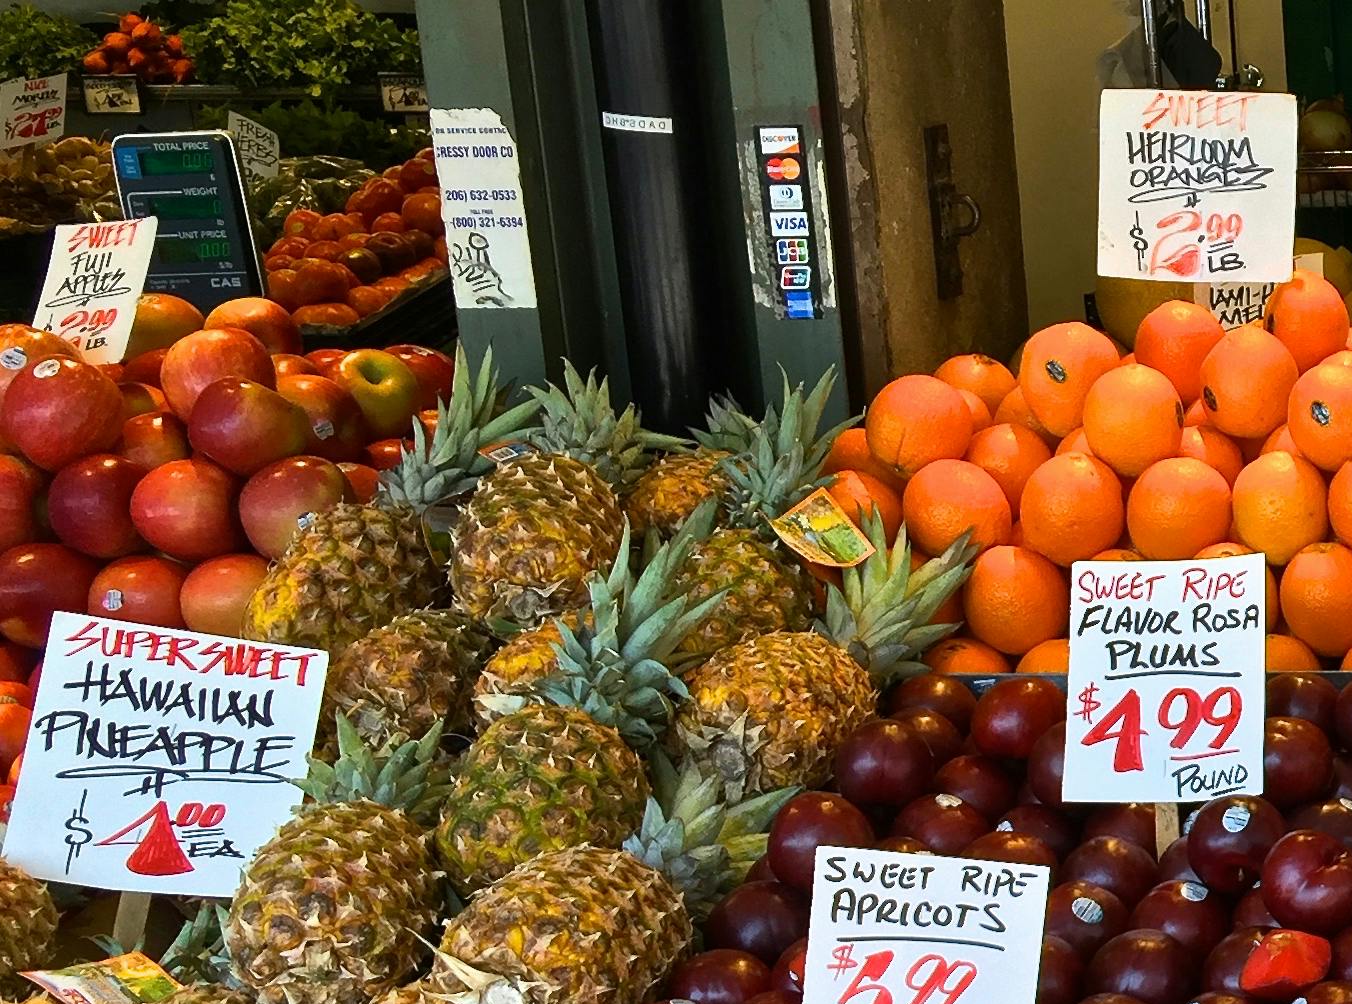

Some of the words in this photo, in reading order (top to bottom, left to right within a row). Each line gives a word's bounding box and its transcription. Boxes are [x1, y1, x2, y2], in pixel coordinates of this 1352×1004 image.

[1142, 93, 1259, 132] SWEET
[153, 142, 181, 151] TOTAL
[182, 141, 209, 150] PRICE
[472, 146, 498, 158] DOOR
[501, 146, 513, 157] CO
[762, 135, 797, 143] DISCOVER
[1127, 131, 1259, 167] HEIRLOOM
[1130, 164, 1274, 188] ORANGES
[183, 187, 218, 196] WEIGHT
[470, 190, 517, 201] 632-0533
[68, 219, 143, 252] SWEET
[178, 231, 199, 240] UNIT
[200, 230, 227, 239] PRICE
[775, 218, 807, 230] VISA
[71, 251, 112, 275] FUJI
[1208, 254, 1247, 273] LB.
[56, 268, 125, 296] APPLES
[210, 277, 242, 288] CAS
[1078, 570, 1166, 602] SWEET
[1182, 567, 1248, 602] RIPE
[1078, 604, 1182, 637] FLAVOR
[1193, 602, 1259, 633] ROSA
[1105, 639, 1220, 670] PLUMS
[64, 661, 274, 728] HAWAIIAN
[34, 711, 295, 774] PINEAPPLE
[1172, 763, 1248, 797] POUND
[824, 857, 935, 889] SWEET
[961, 866, 1038, 897] RIPE
[831, 888, 1006, 932] APRICOTS
